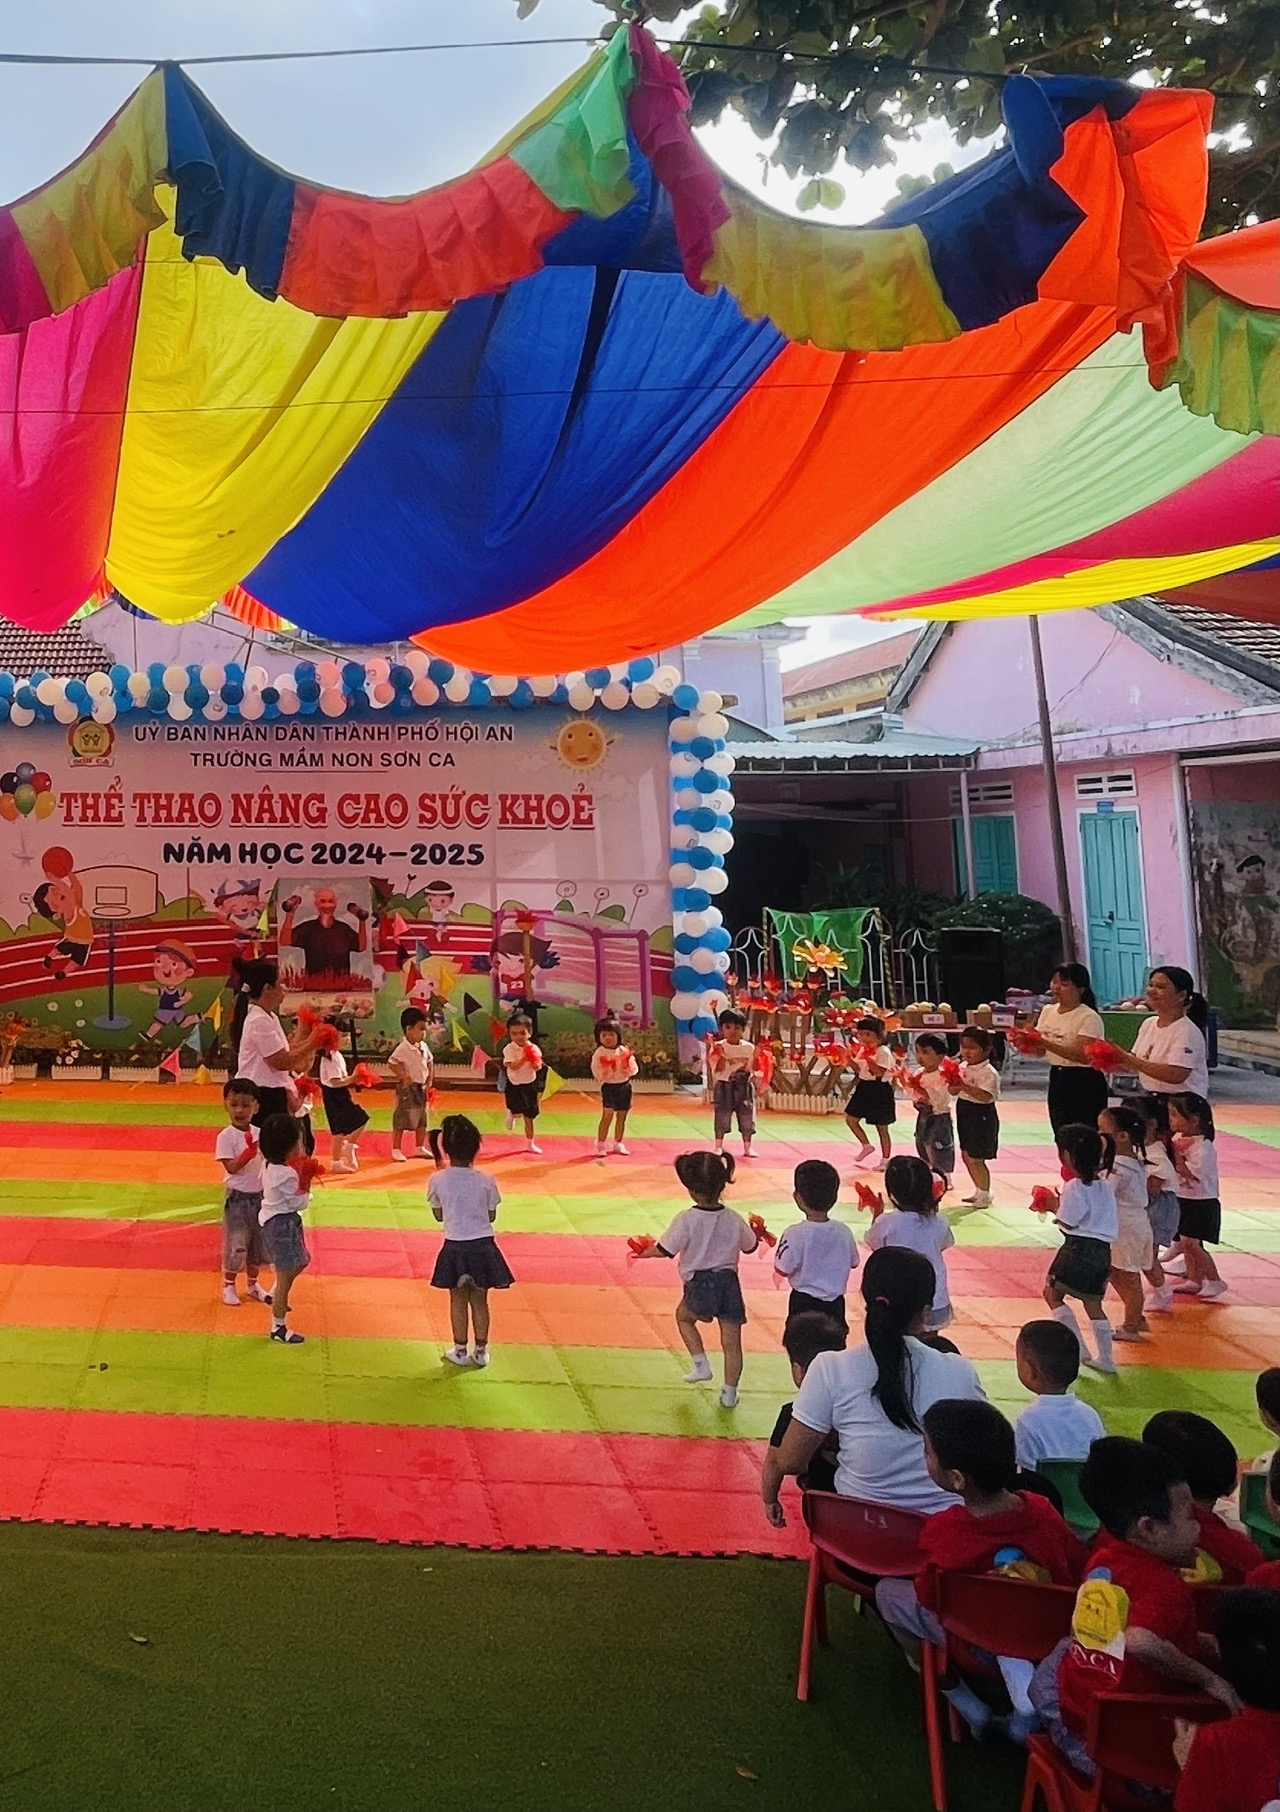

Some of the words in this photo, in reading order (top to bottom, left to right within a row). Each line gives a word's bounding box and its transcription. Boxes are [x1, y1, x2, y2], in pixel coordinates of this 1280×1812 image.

[167, 726, 206, 741] BAN
[214, 722, 267, 741] NHÂN
[275, 722, 315, 741] DÂN
[322, 722, 390, 741] THÀNH
[397, 719, 439, 741] PHỐ
[445, 722, 479, 744] HỘI
[485, 726, 513, 741] AN
[190, 748, 273, 767] TRƯỜNG
[331, 752, 373, 767] NON
[380, 750, 421, 767] SƠN
[428, 752, 456, 767] CA
[60, 775, 124, 825] THỂ
[133, 792, 223, 826] THAO
[231, 785, 328, 827] NÂNG
[337, 792, 410, 826] CAO
[418, 785, 490, 827] SỨC
[498, 783, 595, 827] KHOẺ
[163, 837, 232, 865] NĂM
[238, 842, 304, 870] HỌC
[509, 980, 524, 989] 23
